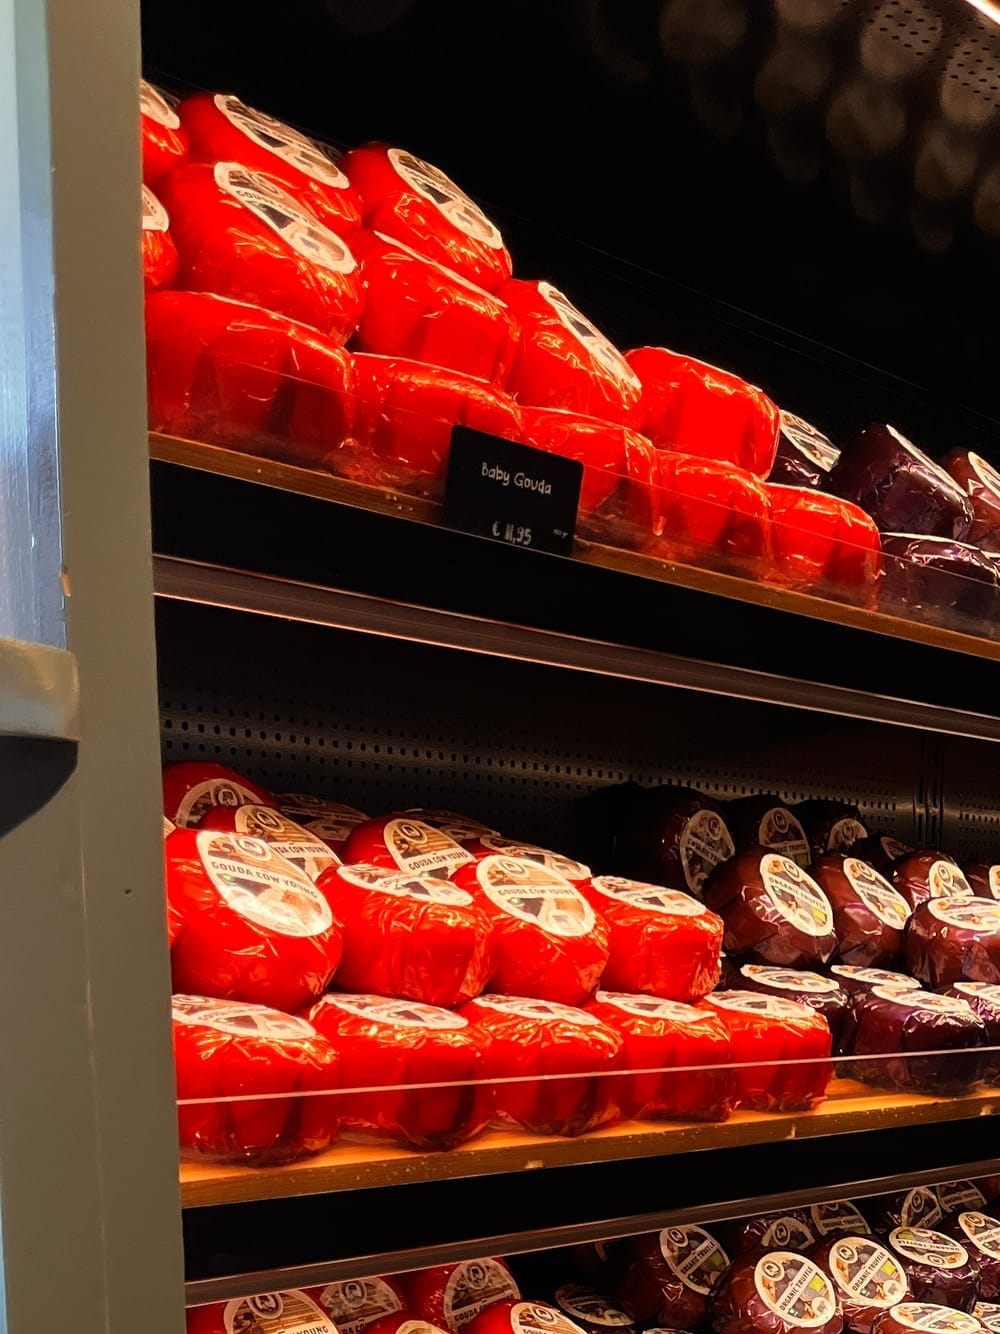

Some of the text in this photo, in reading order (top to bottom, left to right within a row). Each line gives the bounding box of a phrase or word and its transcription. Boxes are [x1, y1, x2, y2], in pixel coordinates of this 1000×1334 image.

[481, 461, 553, 496] Baby Gouda
[492, 520, 502, 538] €
[211, 861, 318, 899] GOUDA COW YOUNG
[779, 1265, 814, 1313] ORGANIC TRUFFLE
[851, 1250, 887, 1293] ORGANIC TRUFFLE
